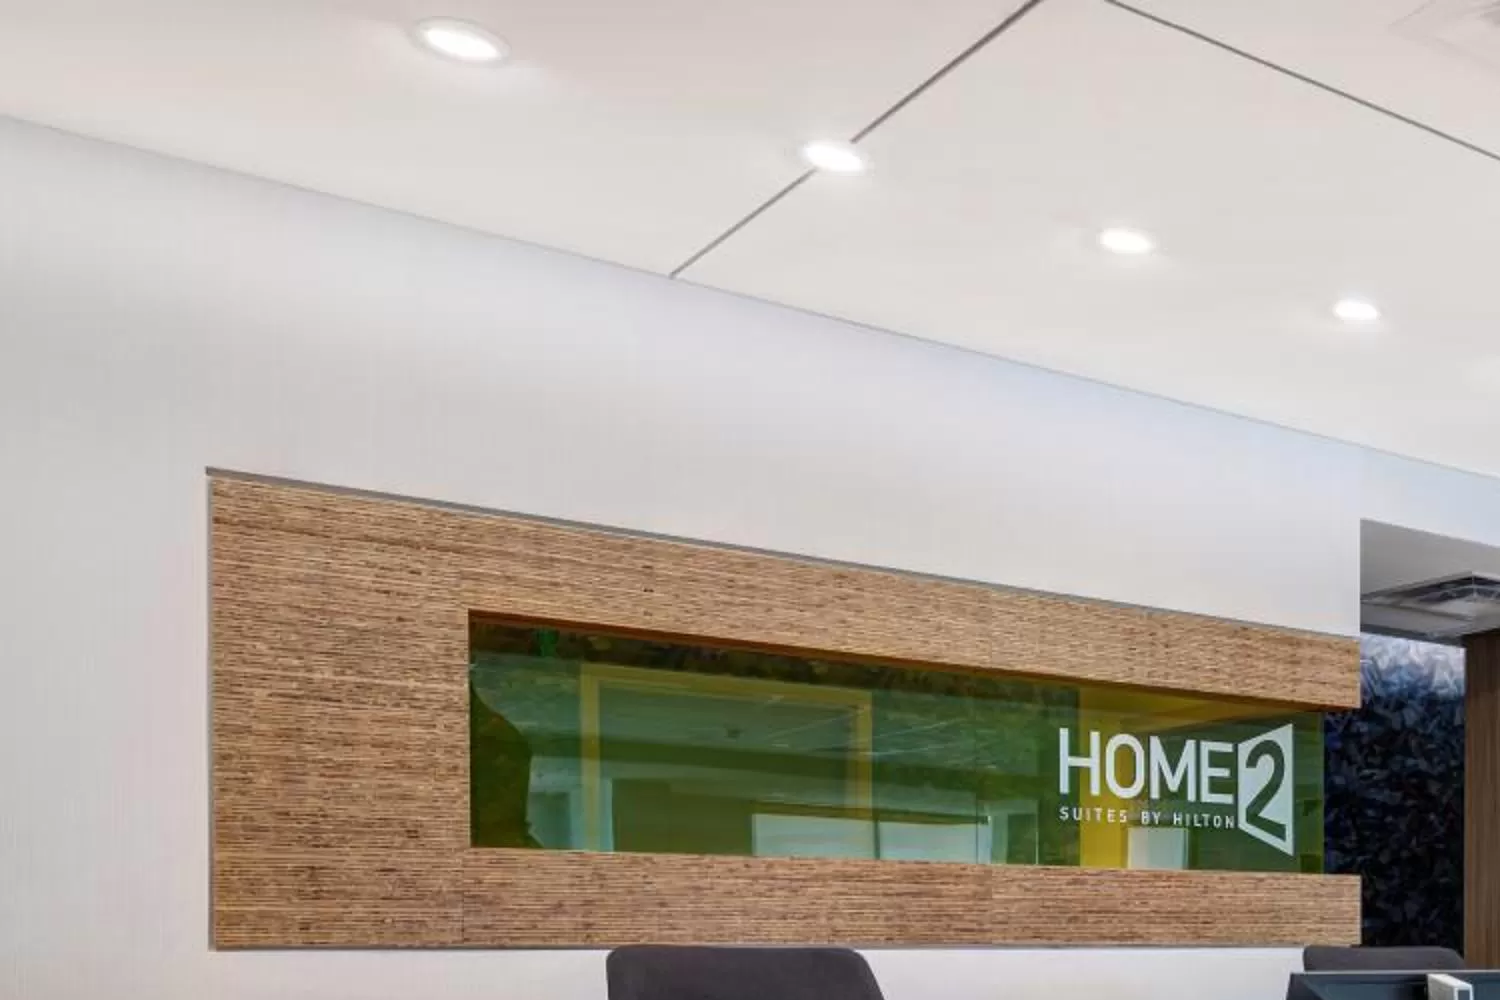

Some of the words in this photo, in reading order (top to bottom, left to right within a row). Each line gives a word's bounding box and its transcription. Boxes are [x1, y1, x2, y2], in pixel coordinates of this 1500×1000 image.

[1059, 806, 1128, 823] SUITES
[1141, 811, 1162, 825] BY
[1173, 812, 1235, 829] HILTON
